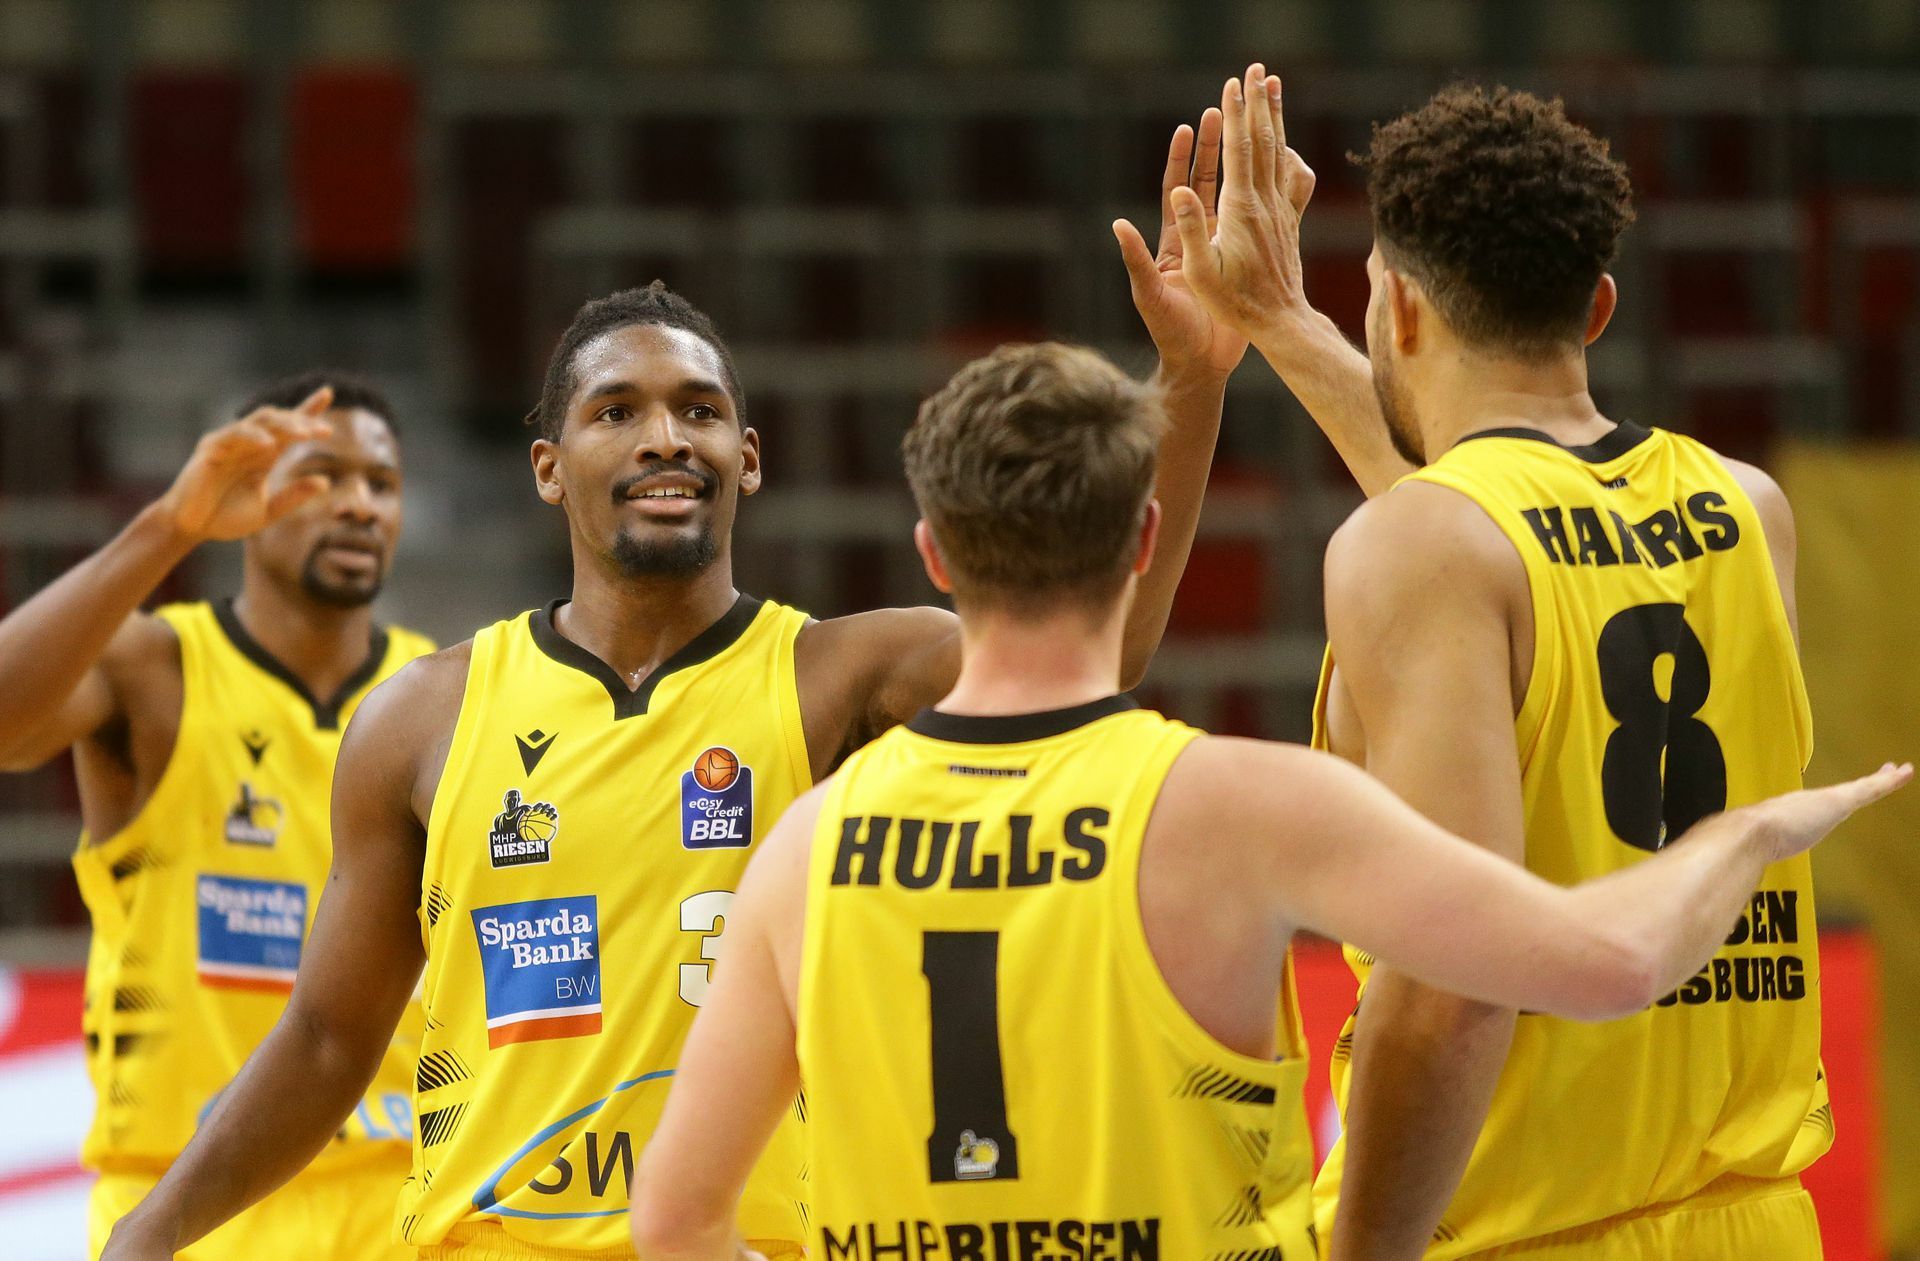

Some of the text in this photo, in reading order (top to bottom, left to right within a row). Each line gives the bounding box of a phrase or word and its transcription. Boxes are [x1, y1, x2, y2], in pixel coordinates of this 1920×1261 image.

[1597, 602, 1727, 853] 8
[690, 818, 743, 840] BBL
[705, 806, 744, 818] Credit
[493, 832, 517, 844] MHP
[493, 840, 546, 858] RIESEN
[830, 807, 1110, 889] HULLS
[479, 909, 593, 950] Sparda
[510, 937, 594, 969] Bank
[678, 890, 736, 1008] 3
[556, 975, 596, 999] BW
[922, 931, 1020, 1183] 1
[945, 1218, 1160, 1261] RIESEN
